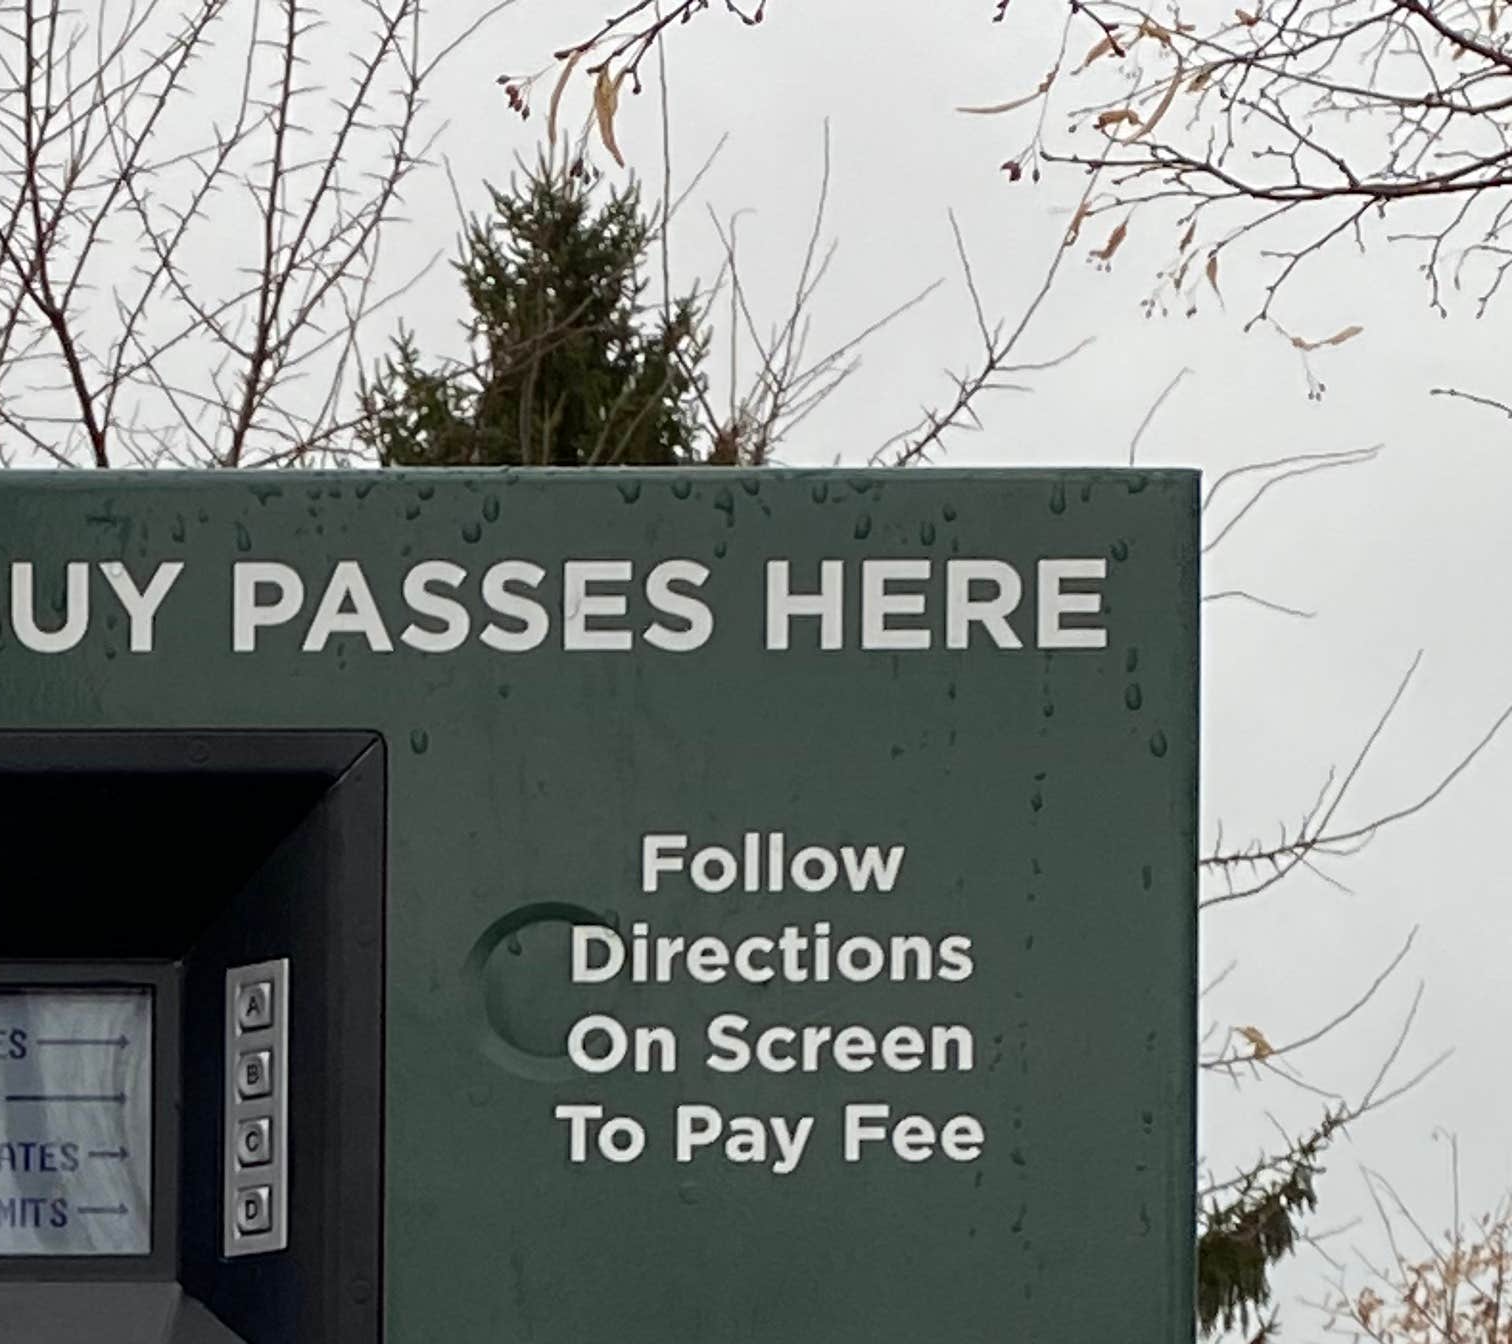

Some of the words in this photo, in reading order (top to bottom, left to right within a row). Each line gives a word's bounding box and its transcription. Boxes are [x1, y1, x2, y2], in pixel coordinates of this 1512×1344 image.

[233, 560, 713, 653] PASSES
[766, 558, 1107, 650] HERE
[642, 832, 905, 893] Follow
[572, 922, 973, 983] Directions
[246, 996, 260, 1017] A
[567, 1015, 676, 1073] On
[706, 1014, 973, 1073] Screen
[247, 1064, 259, 1084] B
[246, 1132, 259, 1151] C
[555, 1105, 645, 1162] To
[676, 1105, 814, 1174] Pay
[845, 1104, 985, 1162] Fee
[245, 1200, 258, 1219] D
